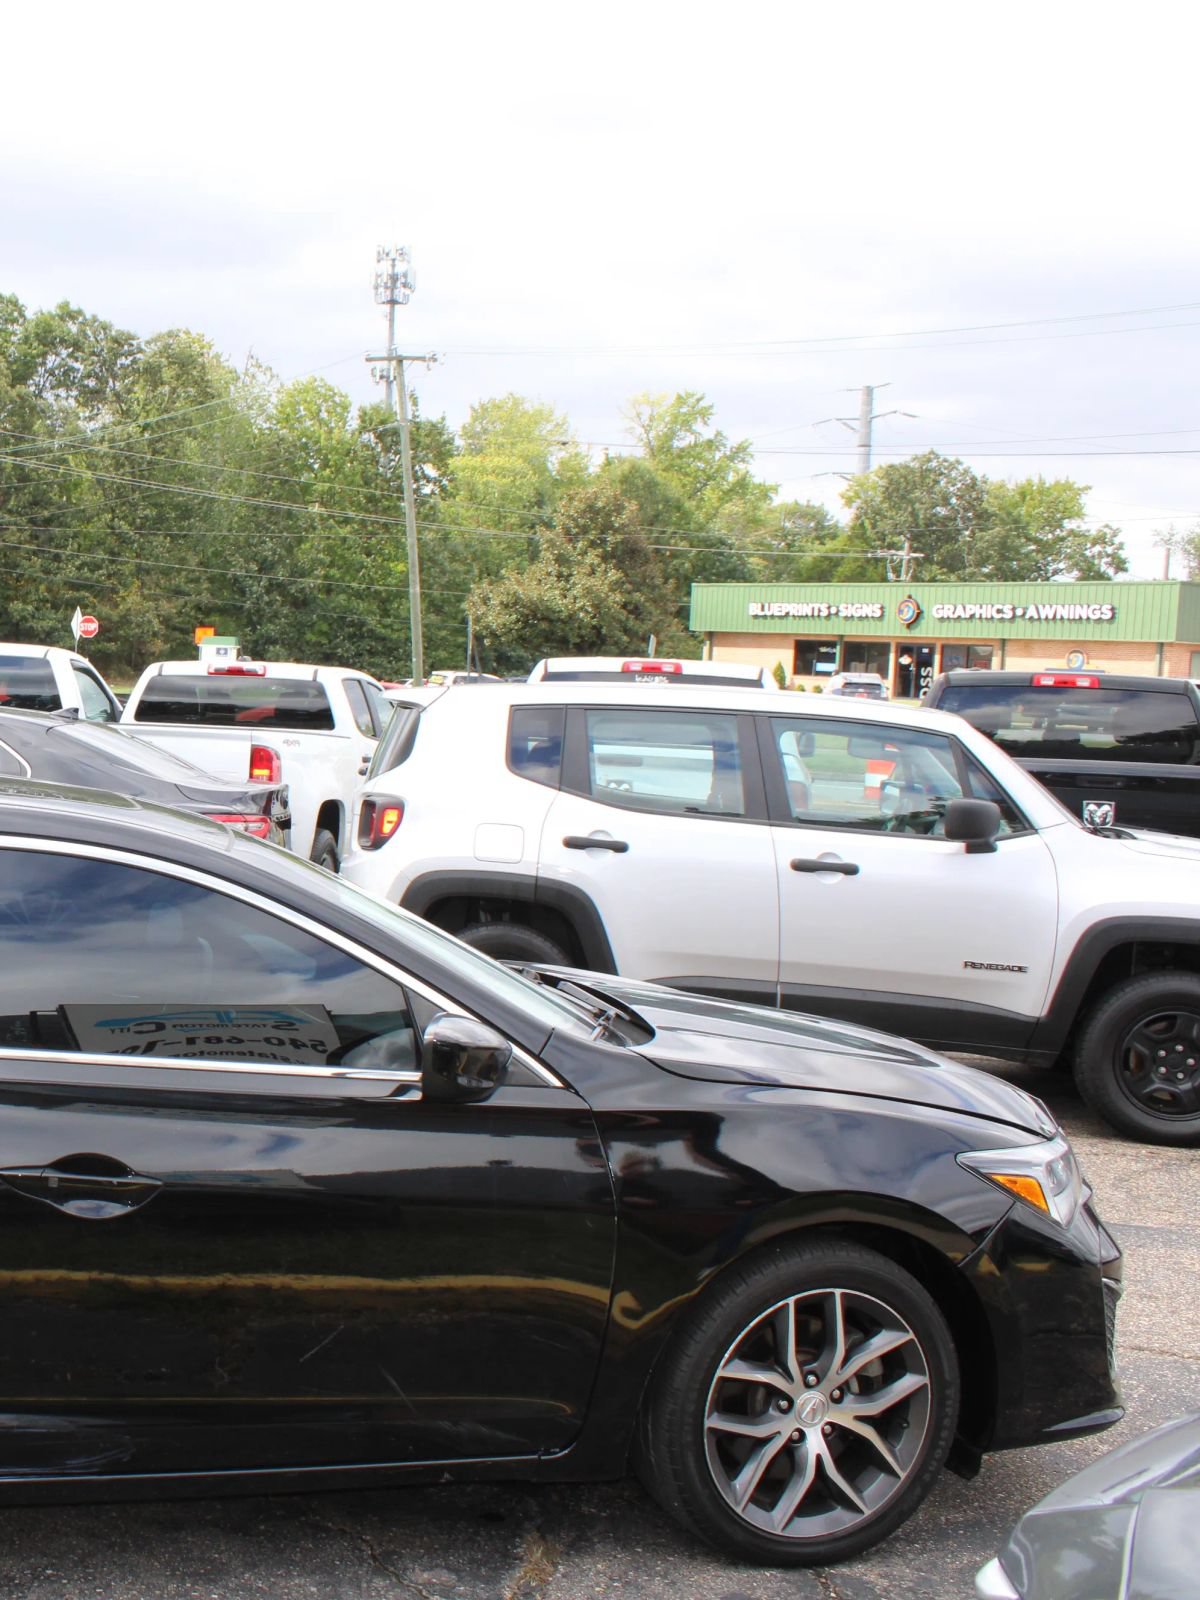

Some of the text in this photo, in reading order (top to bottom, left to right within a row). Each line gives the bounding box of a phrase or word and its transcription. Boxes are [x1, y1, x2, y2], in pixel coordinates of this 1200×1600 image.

[749, 603, 883, 618] BLUEPRINTS SIGNS
[932, 604, 1113, 620] GRAPHICS AWNINGS
[80, 622, 97, 631] STOP
[964, 960, 1029, 973] RENEGADE
